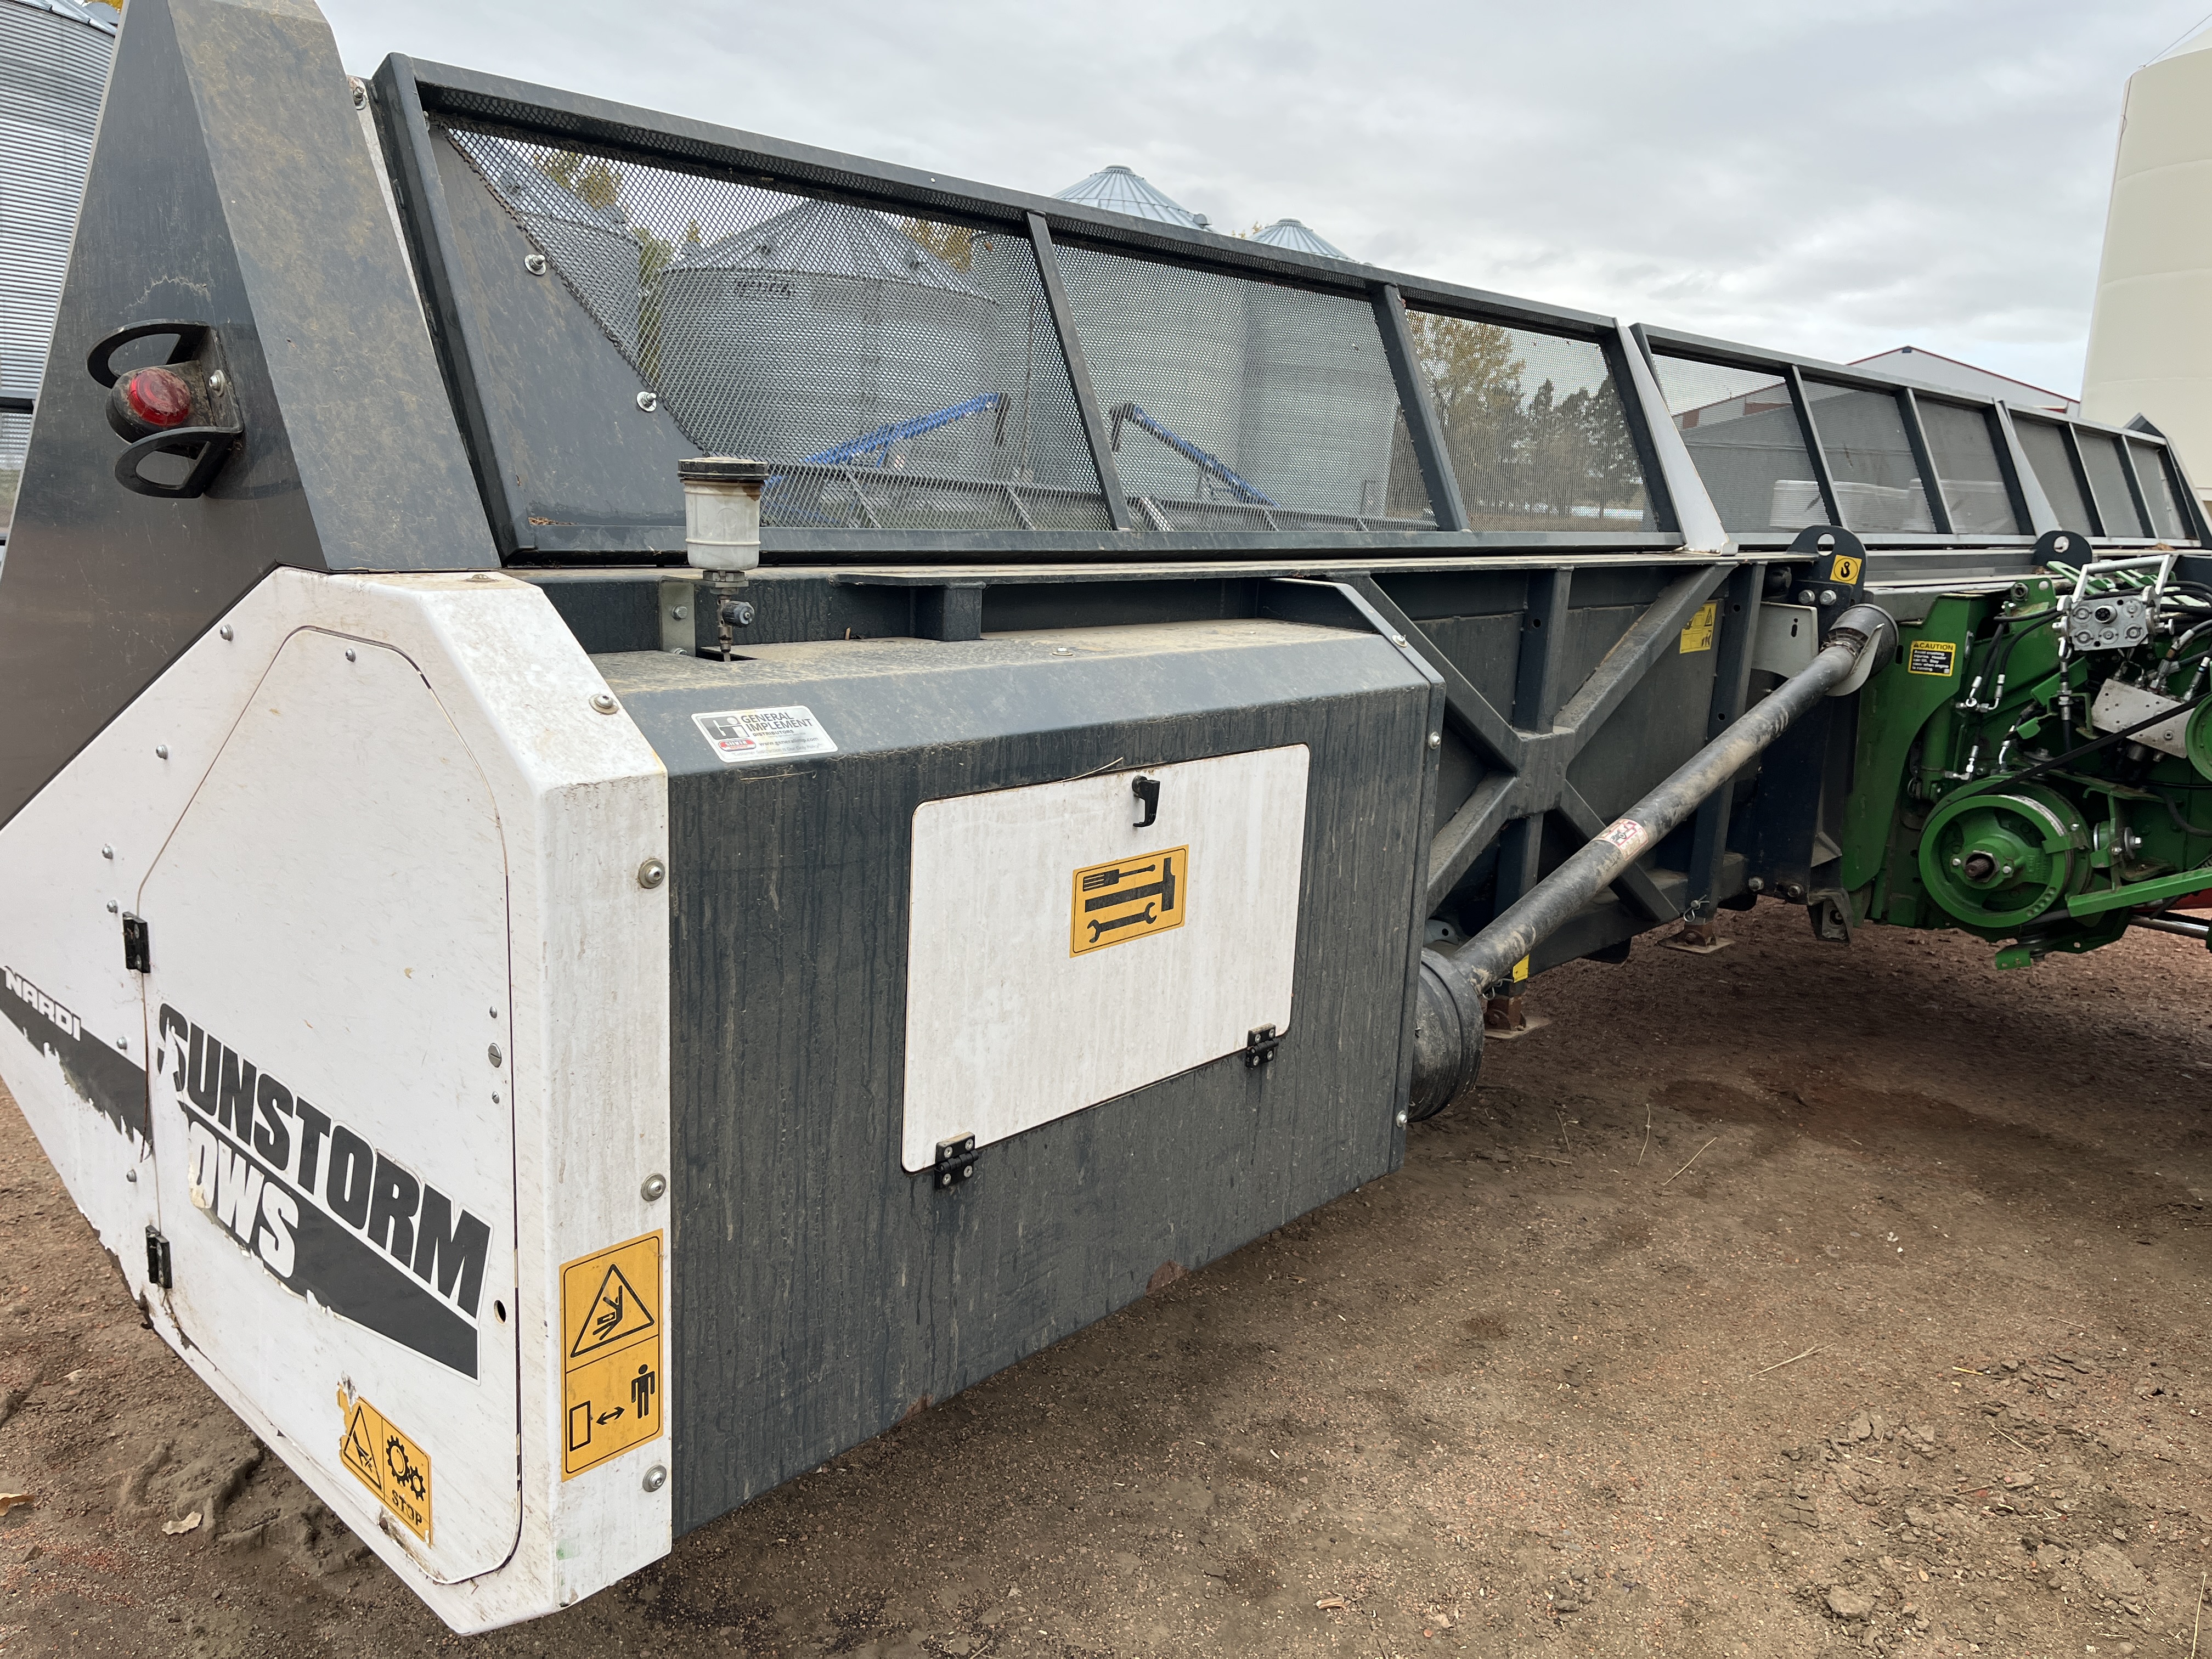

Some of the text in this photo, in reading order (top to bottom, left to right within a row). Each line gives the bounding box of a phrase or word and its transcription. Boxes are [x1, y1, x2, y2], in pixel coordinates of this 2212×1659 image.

[1920, 642, 1953, 651] CAUTION
[741, 712, 794, 723] GENERAL
[746, 719, 812, 732] IMPLEMENT
[759, 737, 819, 747] www.generalimp.com
[4, 966, 81, 1042] NARDI
[157, 1003, 491, 1320] SUNSTORM
[392, 1489, 422, 1526] STOP
